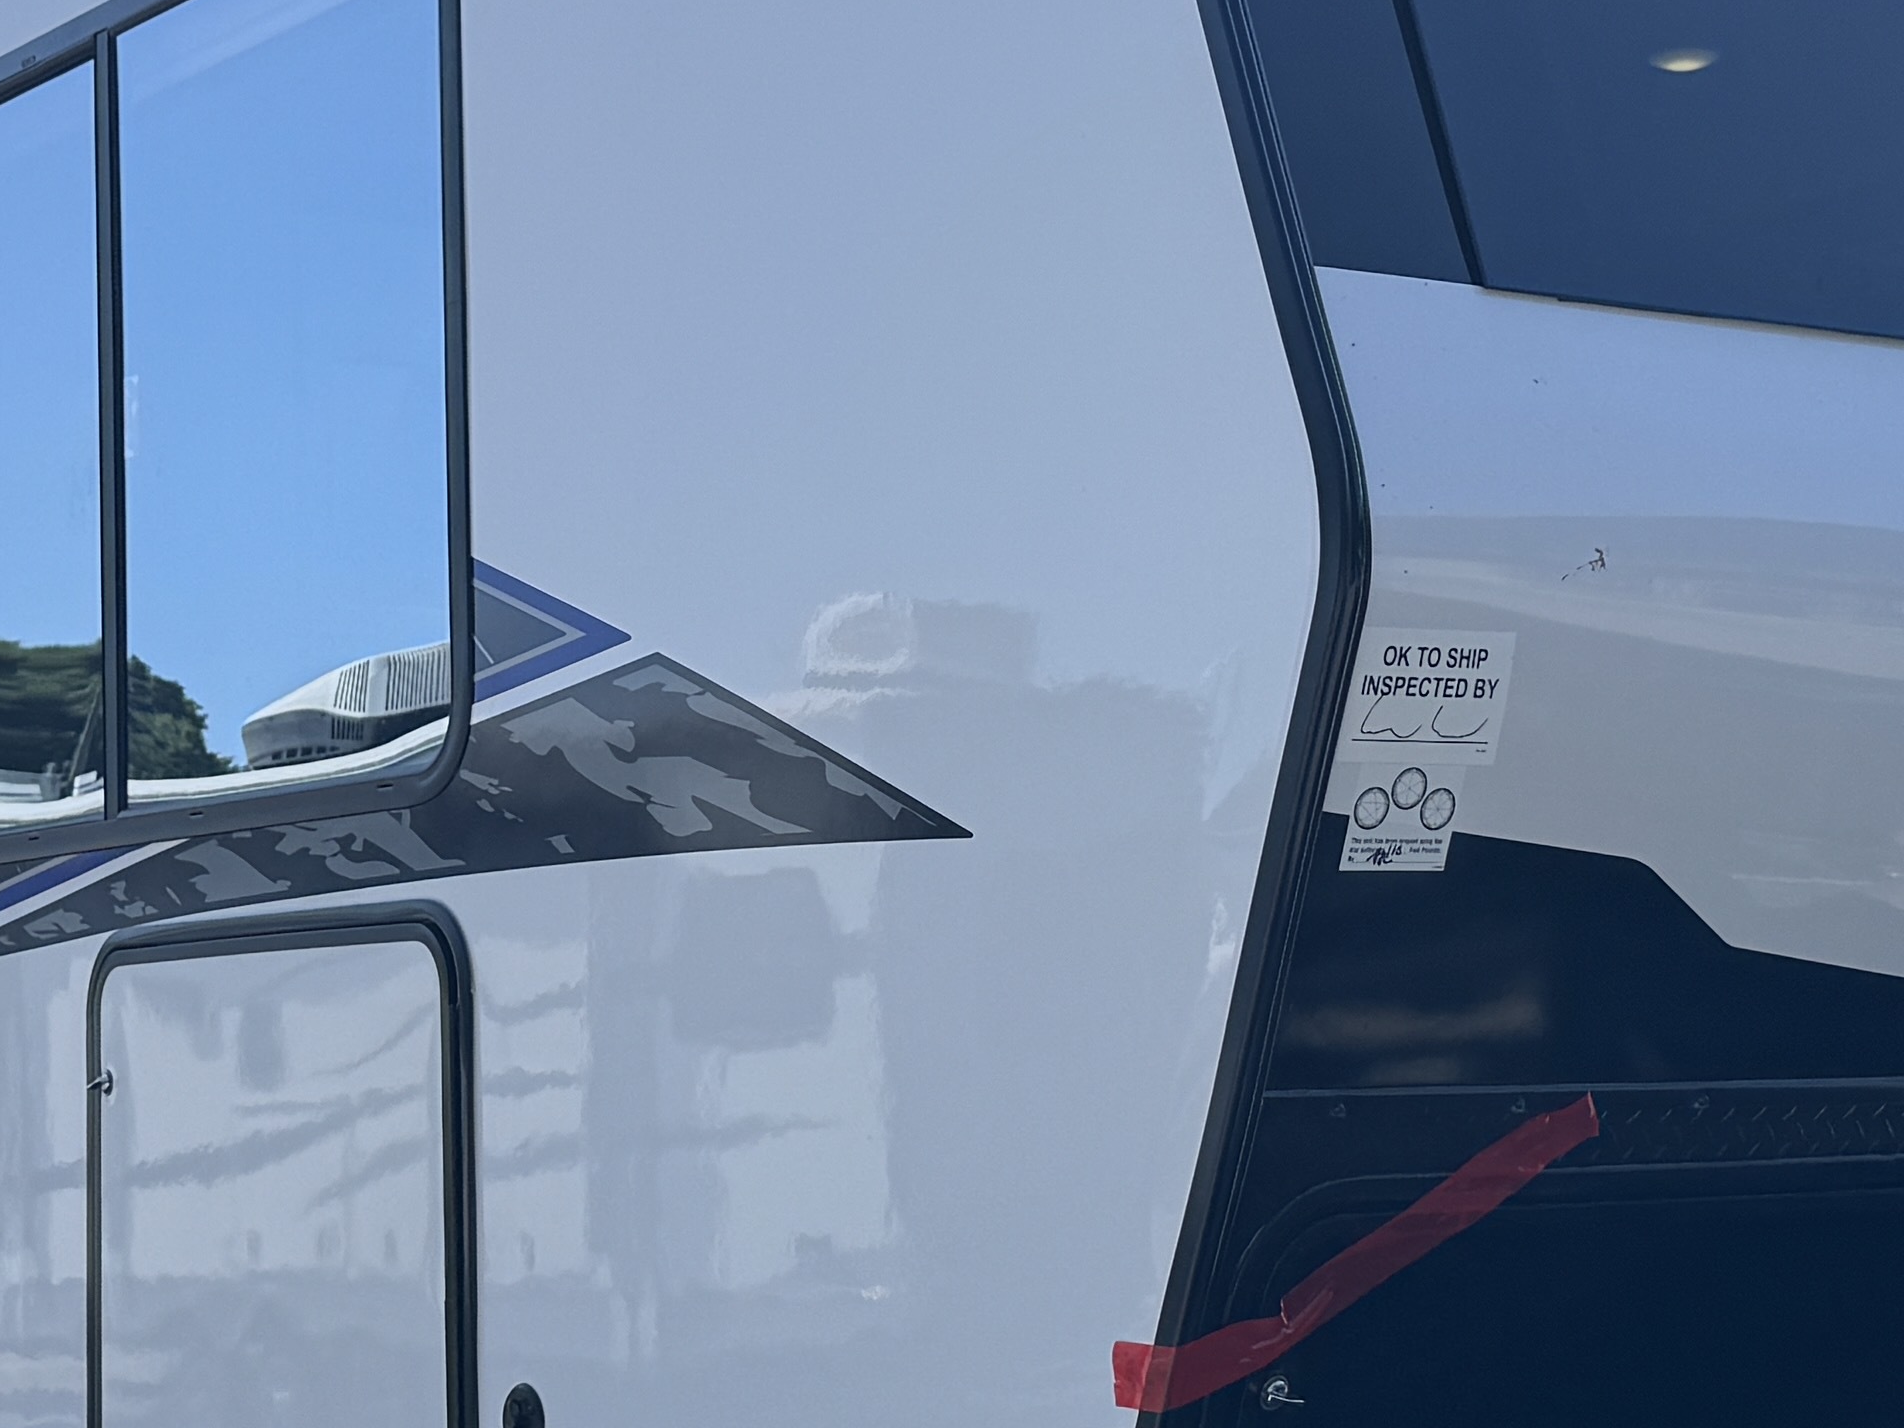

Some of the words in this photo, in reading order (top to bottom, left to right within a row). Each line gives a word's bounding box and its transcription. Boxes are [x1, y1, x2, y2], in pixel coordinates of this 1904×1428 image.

[1383, 645, 1411, 667] OK
[1417, 647, 1441, 668] TO
[1446, 648, 1489, 669] SHIP
[1361, 674, 1468, 698] INSPECTED
[1473, 678, 1500, 699] BY
